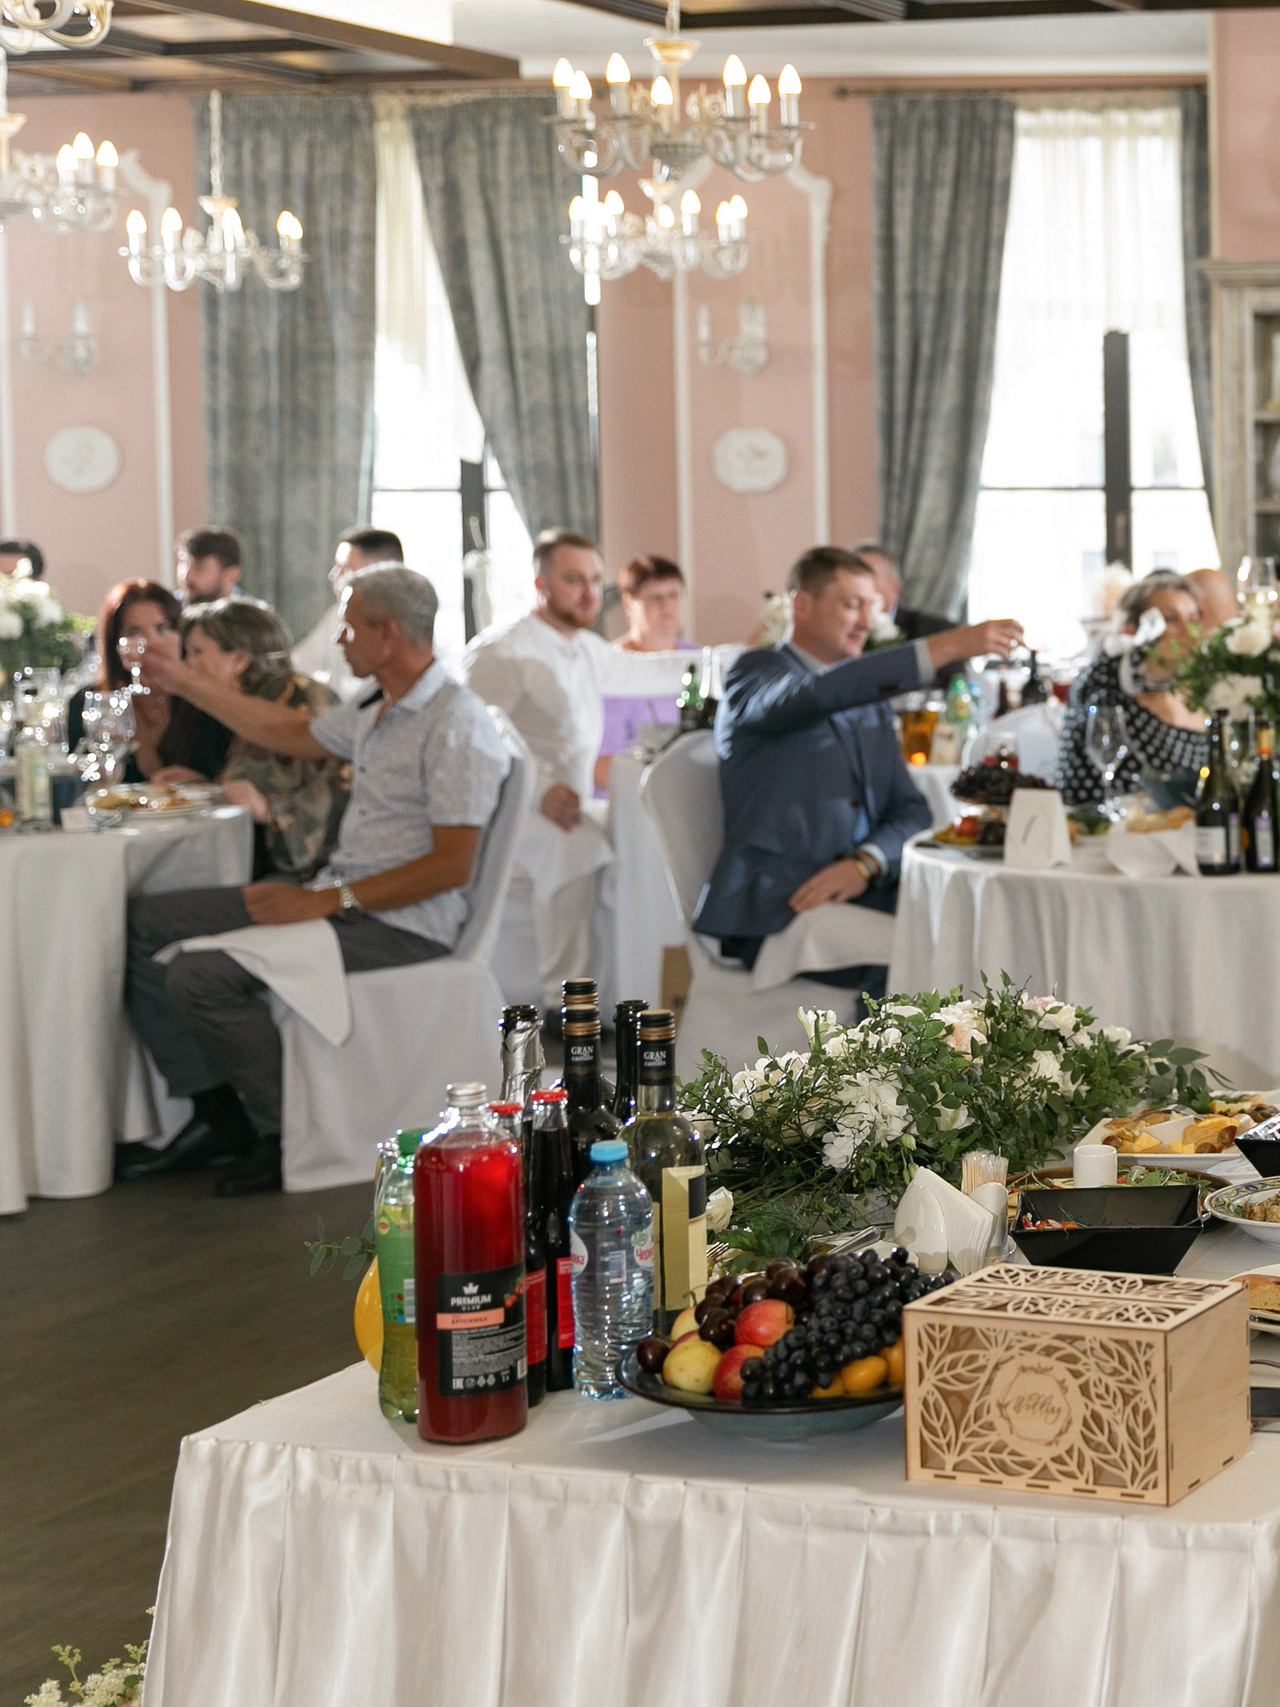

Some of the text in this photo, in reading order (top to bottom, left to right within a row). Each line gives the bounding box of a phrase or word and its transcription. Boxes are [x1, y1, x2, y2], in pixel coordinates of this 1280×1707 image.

[571, 1046, 594, 1055] GRAN
[644, 1051, 666, 1060] GRAN
[450, 1294, 492, 1306] PREMIUM
